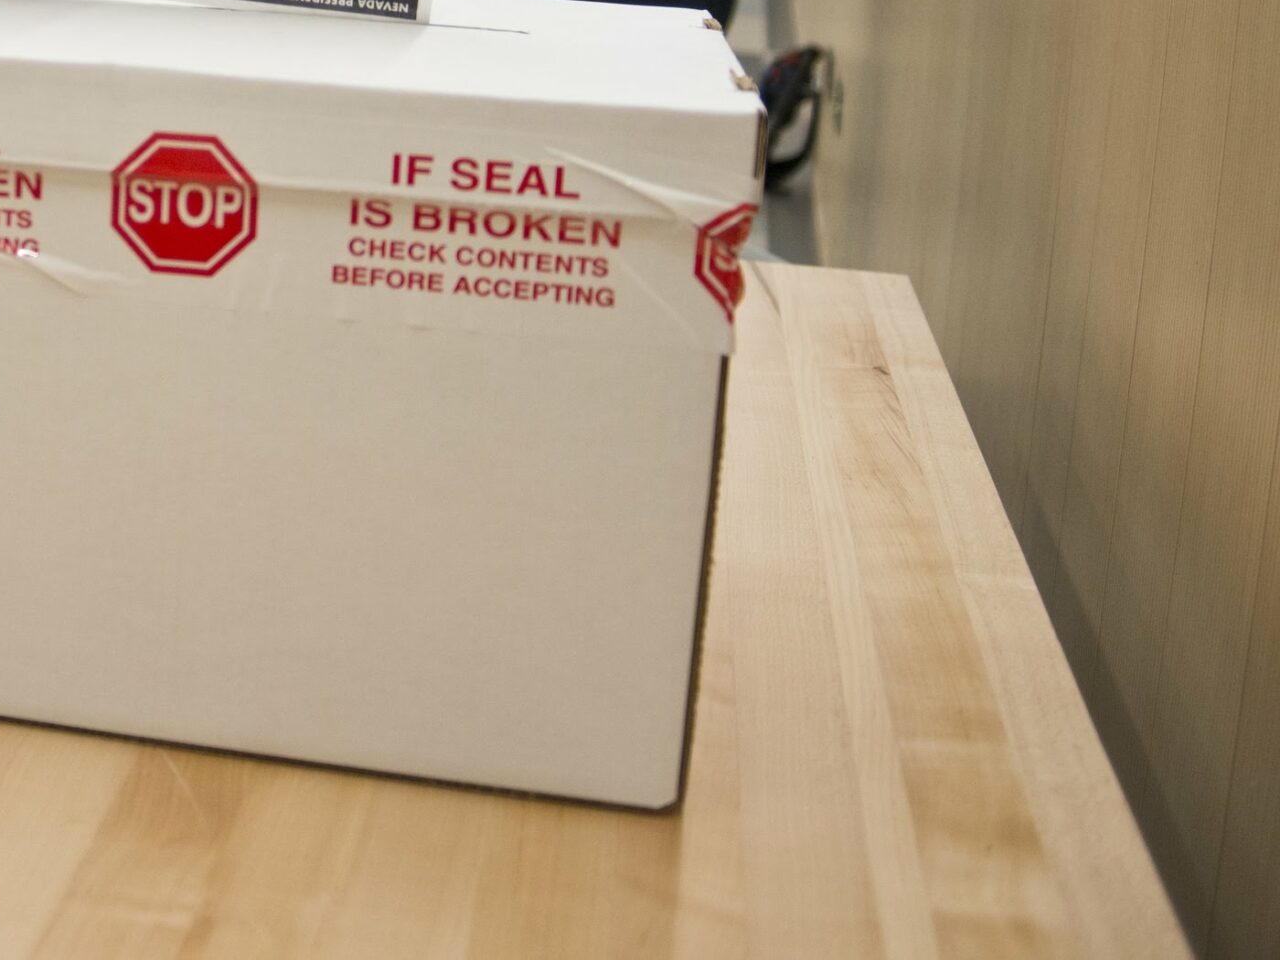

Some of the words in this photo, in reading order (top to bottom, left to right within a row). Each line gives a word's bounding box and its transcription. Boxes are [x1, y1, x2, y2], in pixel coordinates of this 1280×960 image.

[391, 153, 433, 187] IF
[450, 157, 579, 200] SEAL
[126, 180, 244, 231] STOP
[350, 198, 393, 229] IS
[410, 203, 621, 250] BROKEN
[347, 237, 445, 263] CHECK
[455, 243, 611, 280] CONTENTS
[331, 262, 442, 292] BEFORE
[454, 272, 615, 306] ACCEPTING
